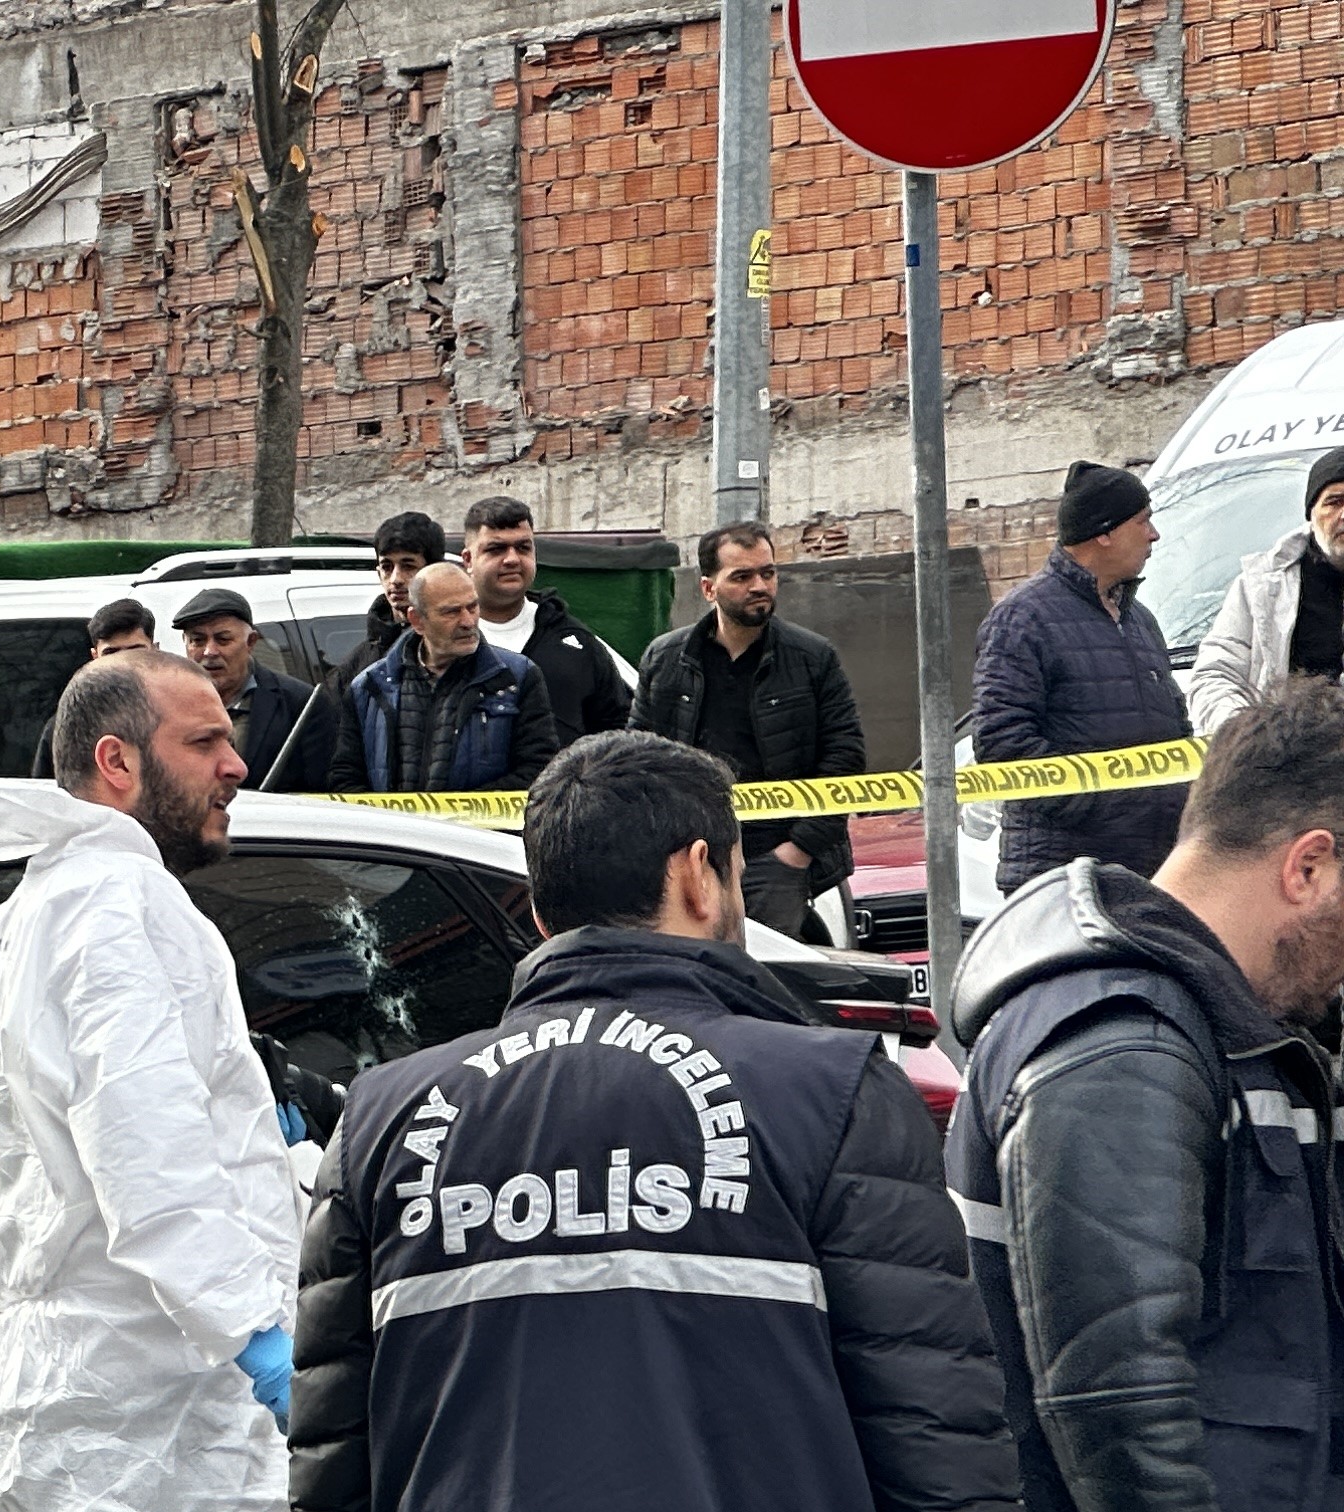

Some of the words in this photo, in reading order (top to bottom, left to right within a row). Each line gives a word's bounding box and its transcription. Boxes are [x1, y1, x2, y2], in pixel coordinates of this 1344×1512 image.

[1214, 418, 1306, 455] OLAY
[395, 1085, 460, 1237] OLAY
[439, 1147, 693, 1255] POLİS
